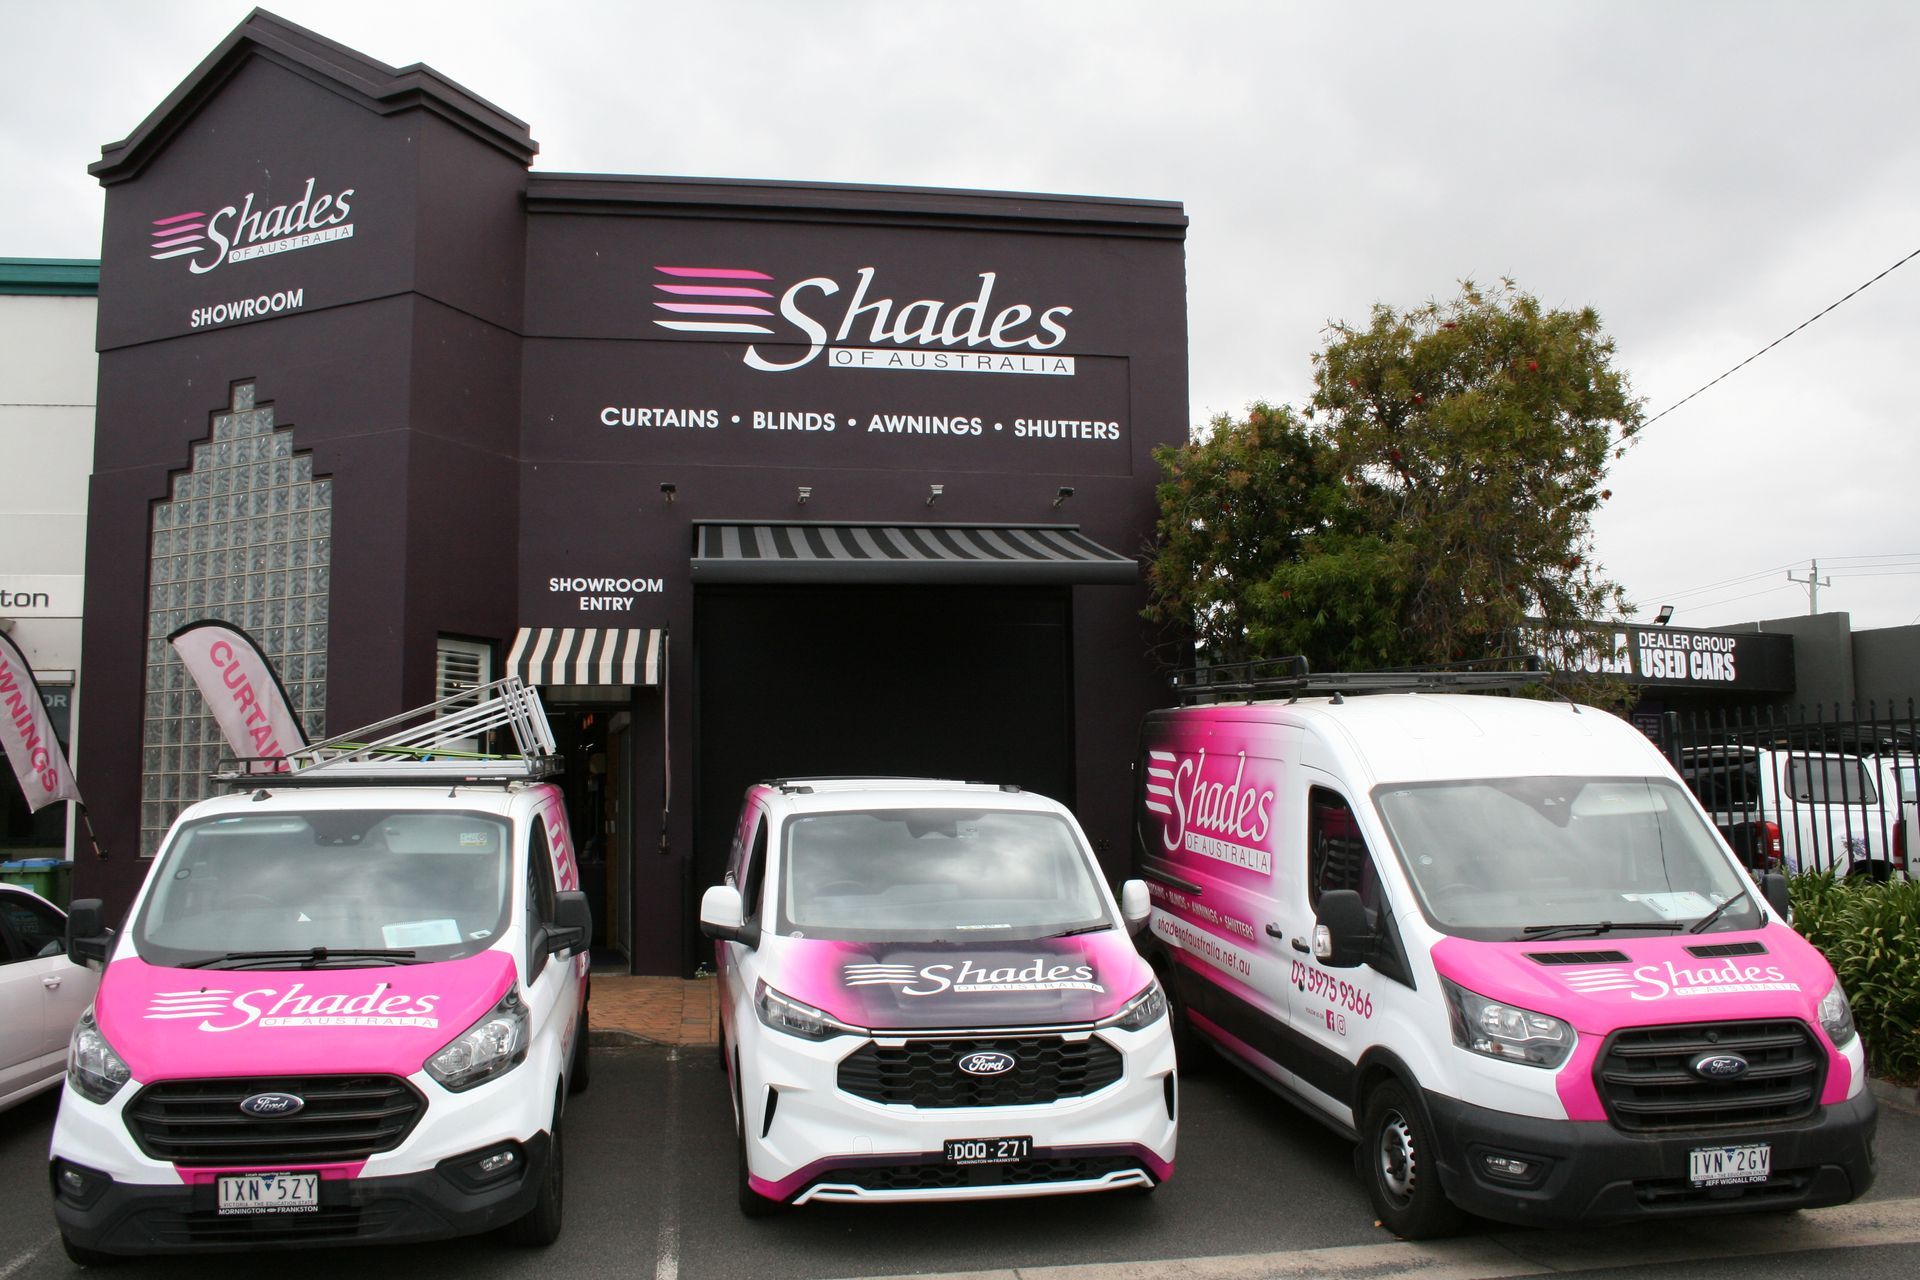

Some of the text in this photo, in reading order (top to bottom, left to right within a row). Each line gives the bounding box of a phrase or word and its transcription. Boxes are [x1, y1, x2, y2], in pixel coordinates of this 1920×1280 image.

[189, 177, 354, 274] Shades
[231, 227, 350, 262] OF AUSTRALIA
[190, 288, 303, 328] SHOWROOM
[743, 267, 1073, 371] Shades
[834, 350, 1069, 373] OF AUSTRALIA
[600, 406, 1120, 441] CURTAINS BLINDS AWNINGS SHUTTERS
[549, 577, 664, 593] SHOWROOM
[579, 596, 634, 611] ENTRY
[1638, 631, 1736, 652] DEALER GROUP
[1639, 648, 1736, 682] USED CARS
[0, 652, 59, 793] WNINGS
[1163, 747, 1274, 851] Shades
[1185, 832, 1269, 872] OF AUSTRALIA
[901, 958, 1094, 996] Shades
[1631, 957, 1785, 1001] Shades
[198, 982, 441, 1033] Shades
[1307, 966, 1337, 1002] 5975
[1339, 981, 1373, 1019] 9366
[263, 1017, 434, 1027] OF AUSTRALIA
[968, 1055, 1005, 1071] Ford
[1711, 1059, 1739, 1073] Ford
[253, 1096, 289, 1112] Ford
[997, 1140, 1027, 1157] 271
[1694, 1149, 1768, 1175] 1VN 2GV
[223, 1177, 316, 1201] 1XN 5ZY
[1720, 1177, 1749, 1185] WIGNALL
[1749, 1175, 1767, 1183] FORD
[218, 1205, 318, 1215] MORNINGTON FRANKSTON
